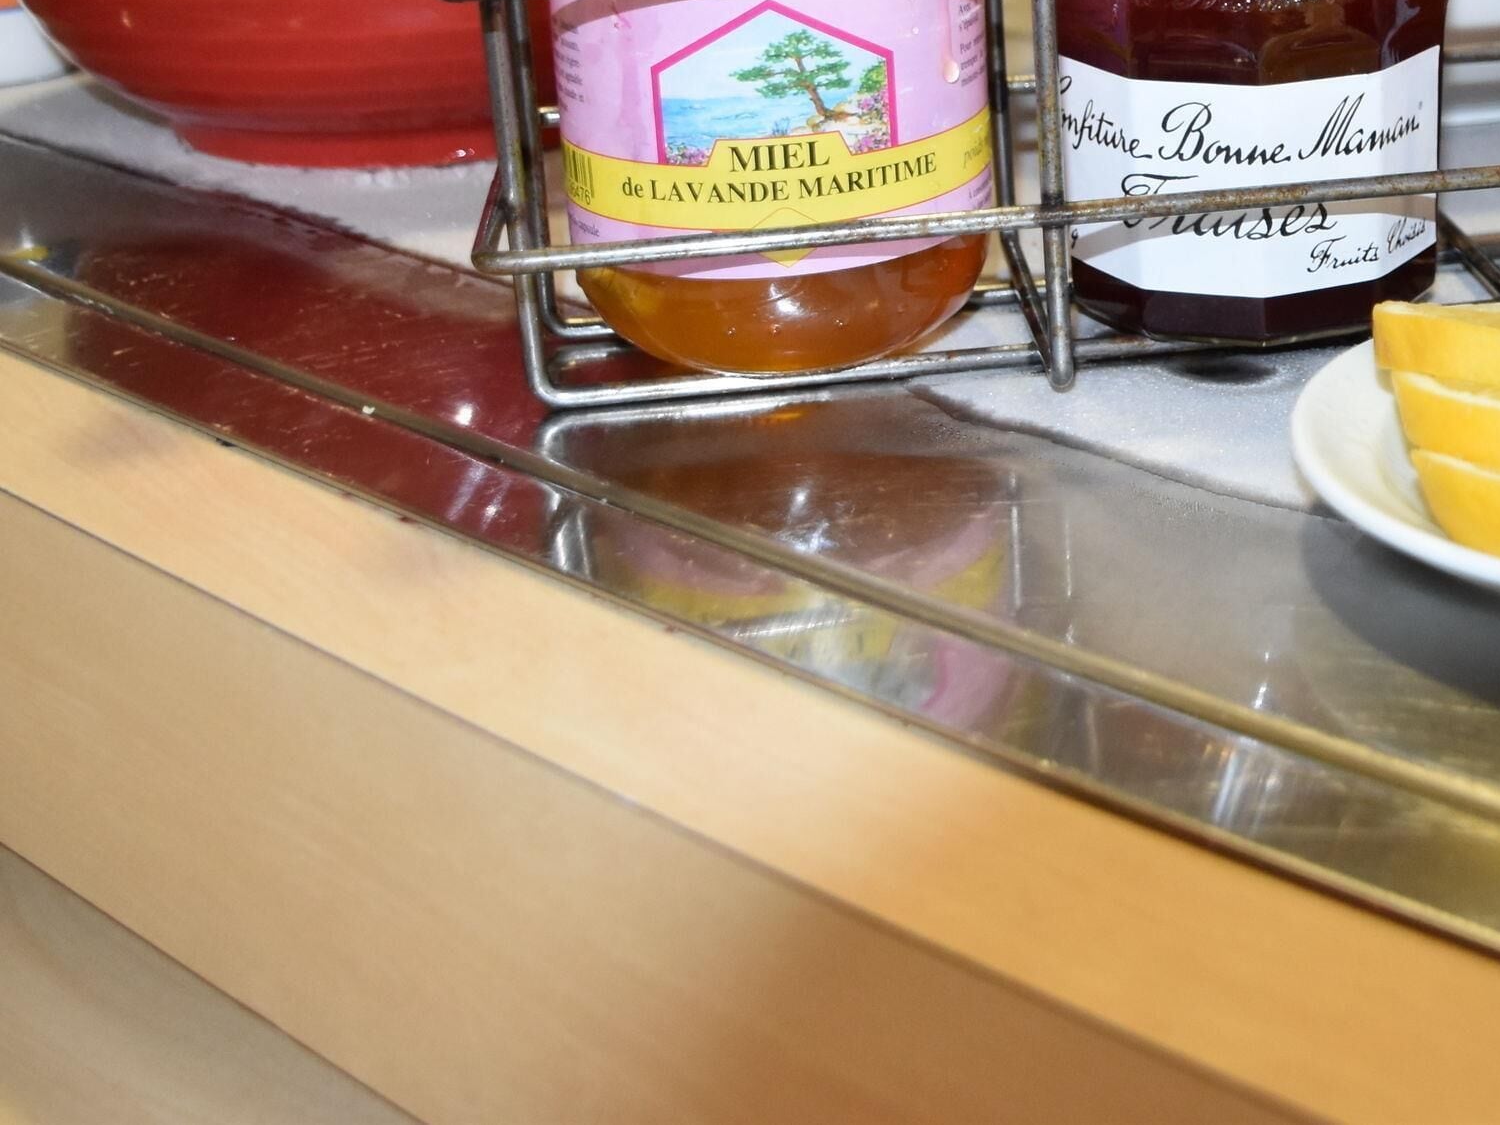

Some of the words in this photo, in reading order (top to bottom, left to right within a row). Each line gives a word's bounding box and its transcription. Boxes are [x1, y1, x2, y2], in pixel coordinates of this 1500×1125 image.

[1060, 75, 1153, 158] nfiture
[1158, 101, 1291, 166] Bonne
[1299, 92, 1420, 161] Maman
[622, 170, 645, 198] de
[650, 176, 791, 204] LAVANDE
[798, 151, 938, 200] MARITIME
[729, 140, 831, 173] MIEL
[1307, 234, 1381, 273] Fruits
